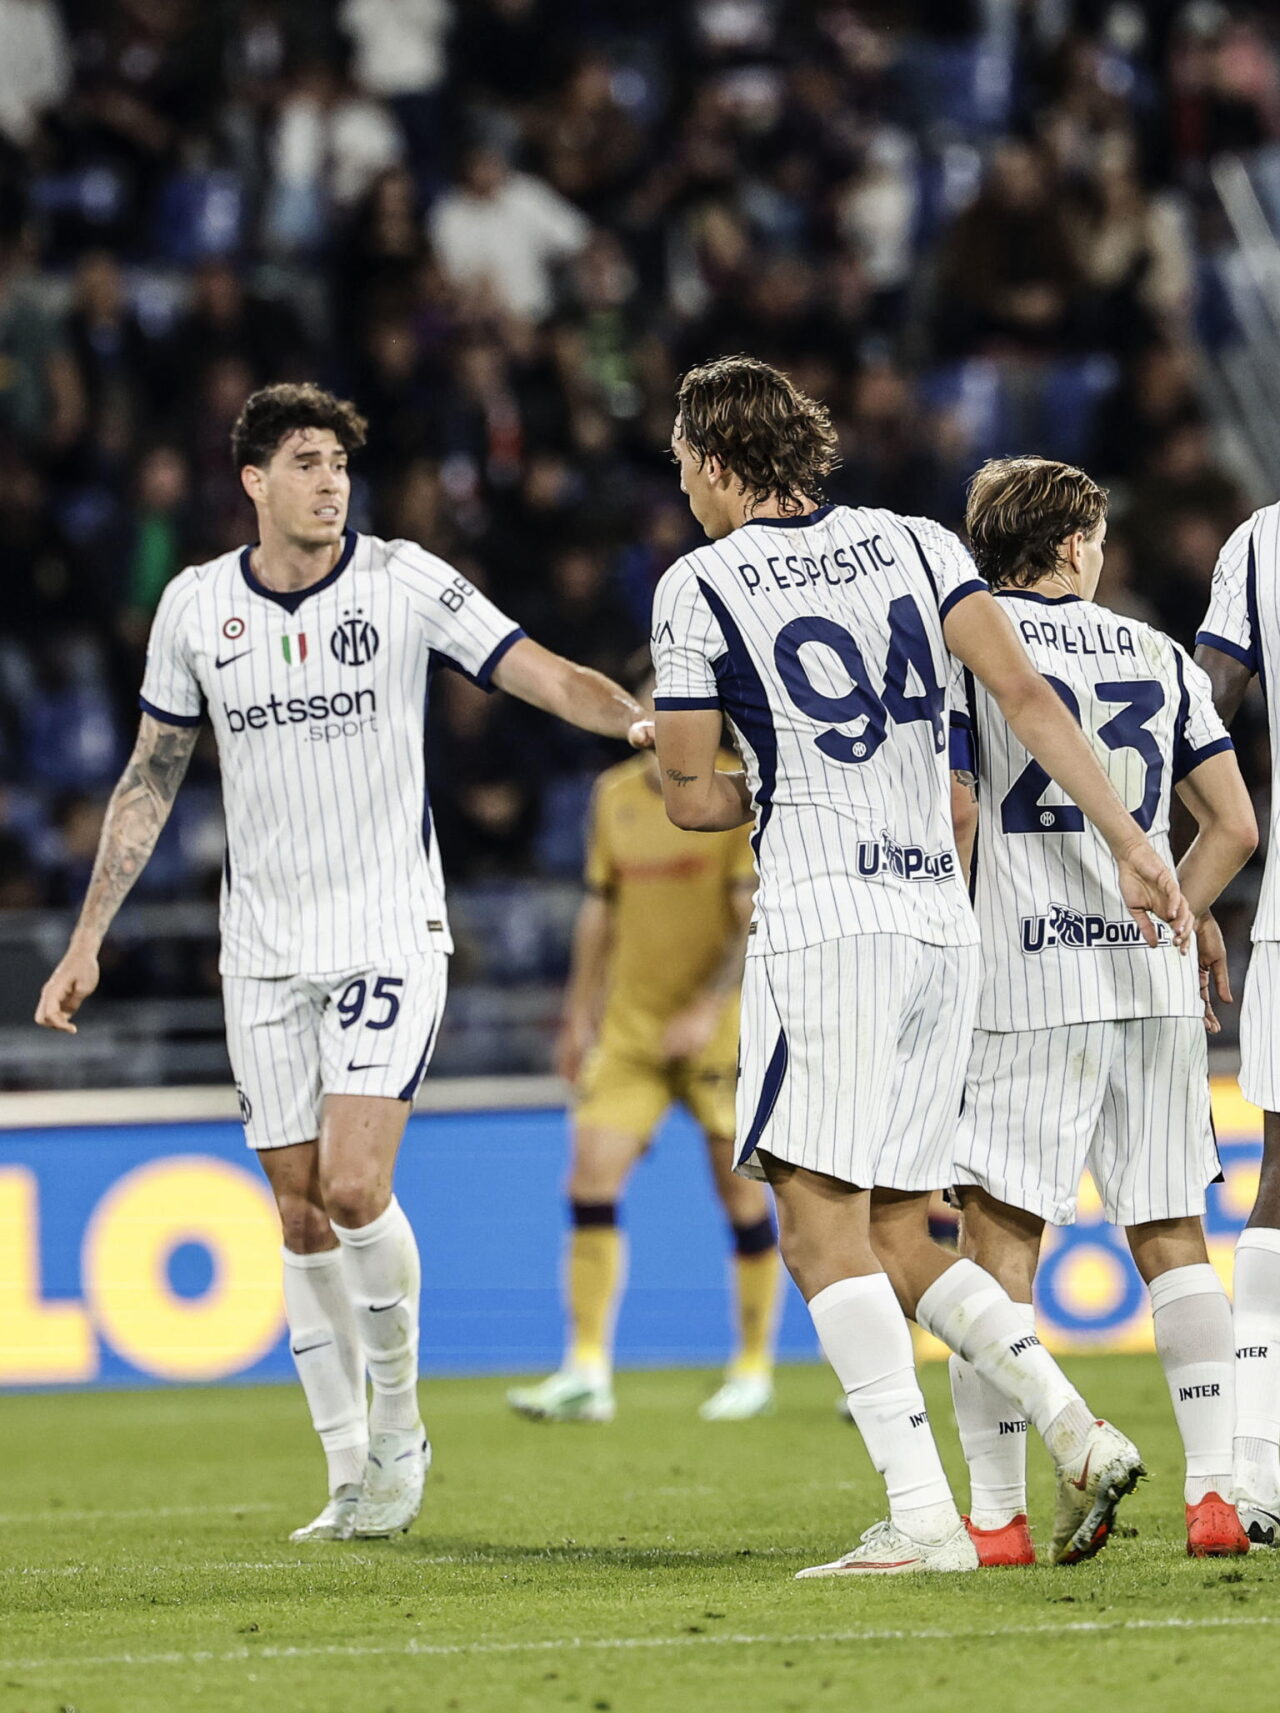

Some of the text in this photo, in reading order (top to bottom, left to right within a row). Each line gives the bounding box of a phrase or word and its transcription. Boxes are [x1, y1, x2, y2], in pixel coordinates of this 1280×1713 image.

[1020, 619, 1136, 658] ARELLA
[773, 593, 946, 764] 94
[223, 689, 376, 734] betsson
[1000, 673, 1165, 835] 23
[337, 977, 403, 1030] 95
[1009, 1334, 1041, 1357] INTE
[1235, 1346, 1269, 1360] NTER
[1179, 1383, 1220, 1401] INTER
[999, 1419, 1028, 1435] INTE
